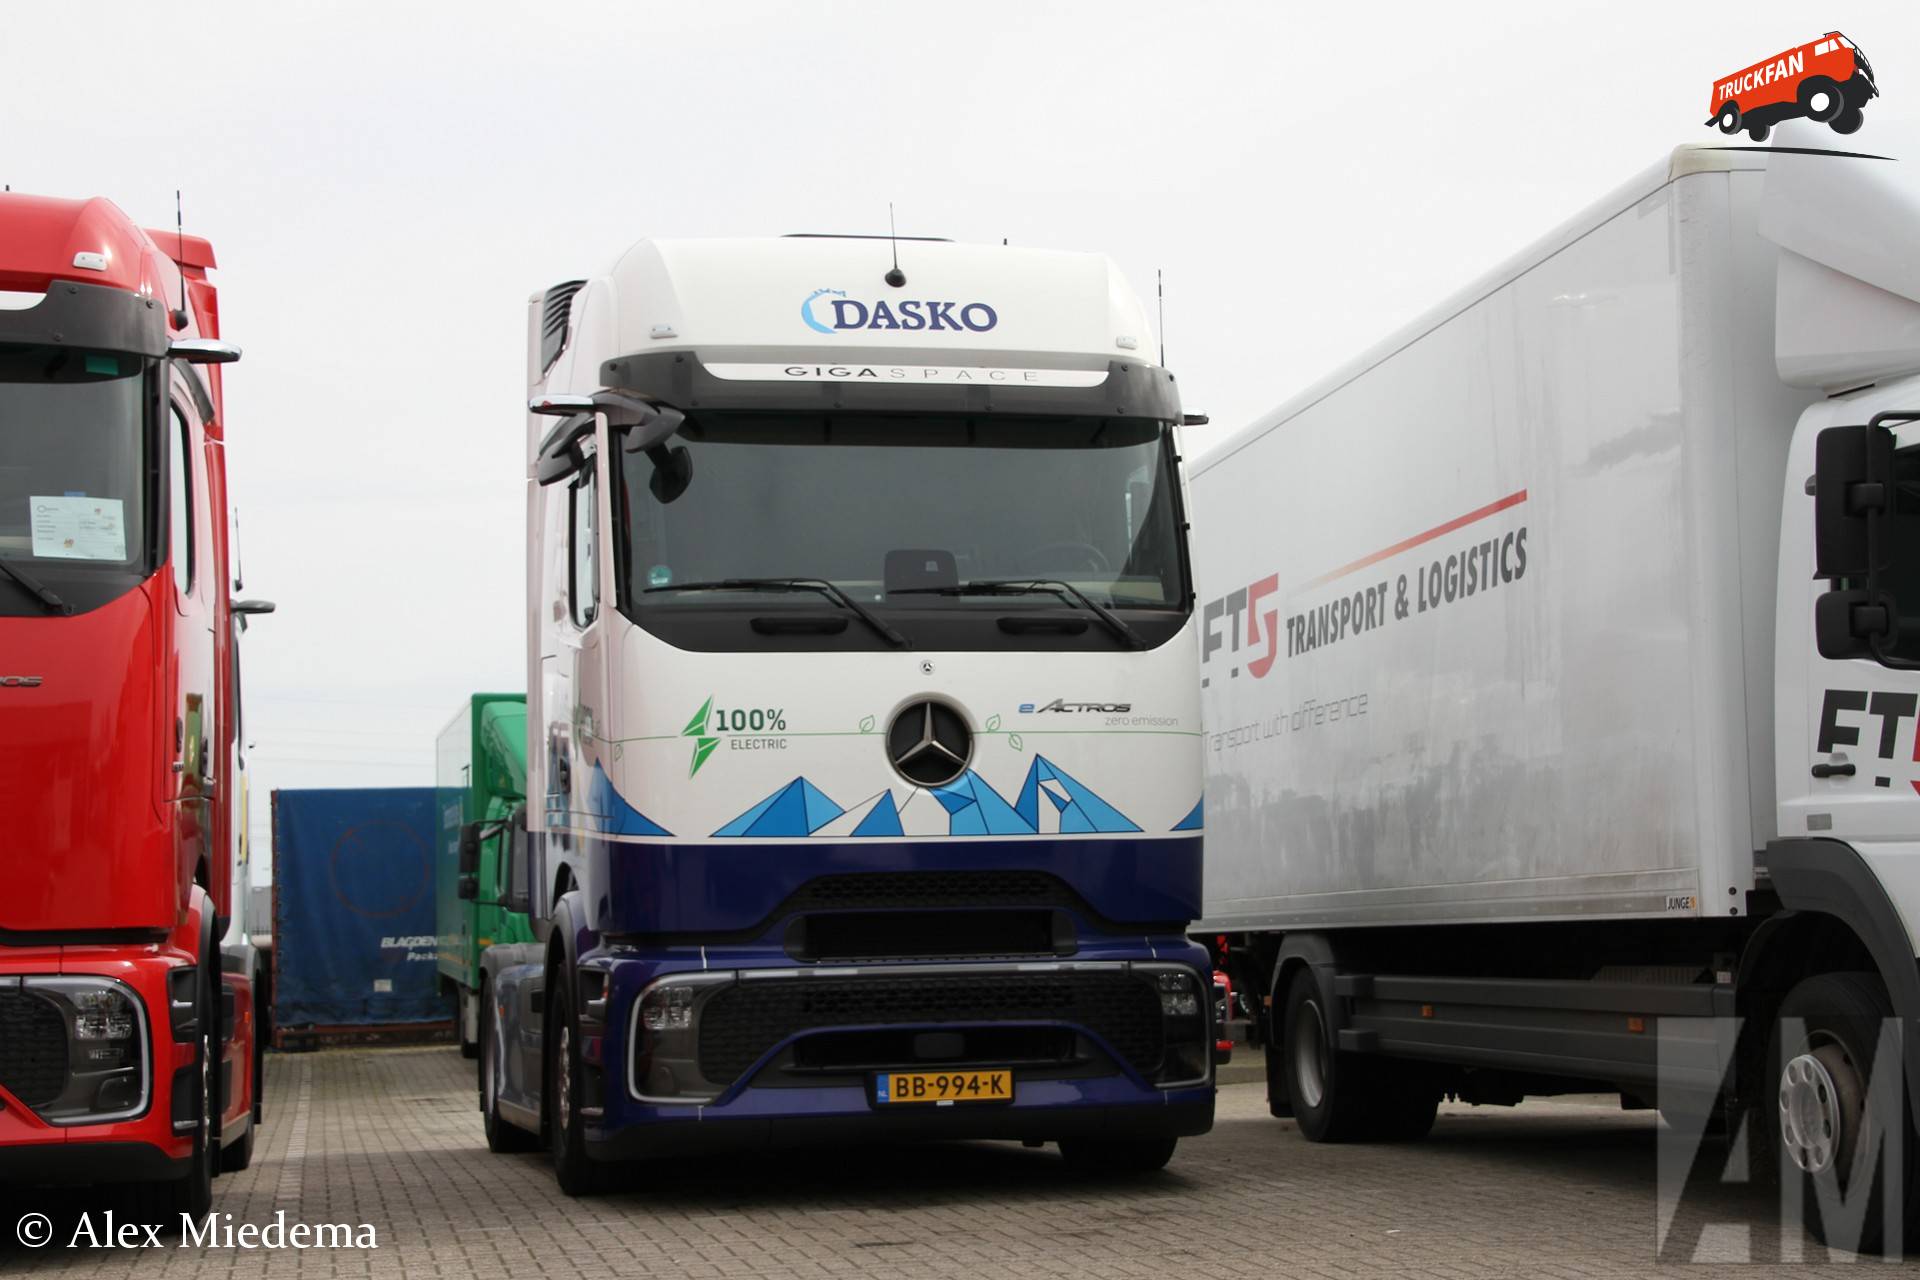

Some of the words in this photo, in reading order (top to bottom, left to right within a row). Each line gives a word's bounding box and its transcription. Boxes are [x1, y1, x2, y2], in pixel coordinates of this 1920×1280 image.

[831, 299, 998, 332] DASKO
[784, 366, 1039, 382] GIGASPACE
[1286, 581, 1388, 658] TRANSPORT
[1394, 573, 1410, 622] &
[1417, 526, 1528, 613] LOGISTICS
[716, 708, 787, 732] 100%
[1104, 716, 1130, 727] zero
[1131, 716, 1179, 727] emission
[730, 738, 788, 750] ELECTRIC
[1817, 688, 1920, 798] FT
[877, 1089, 888, 1098] NL
[895, 1074, 1005, 1098] BB-994-K
